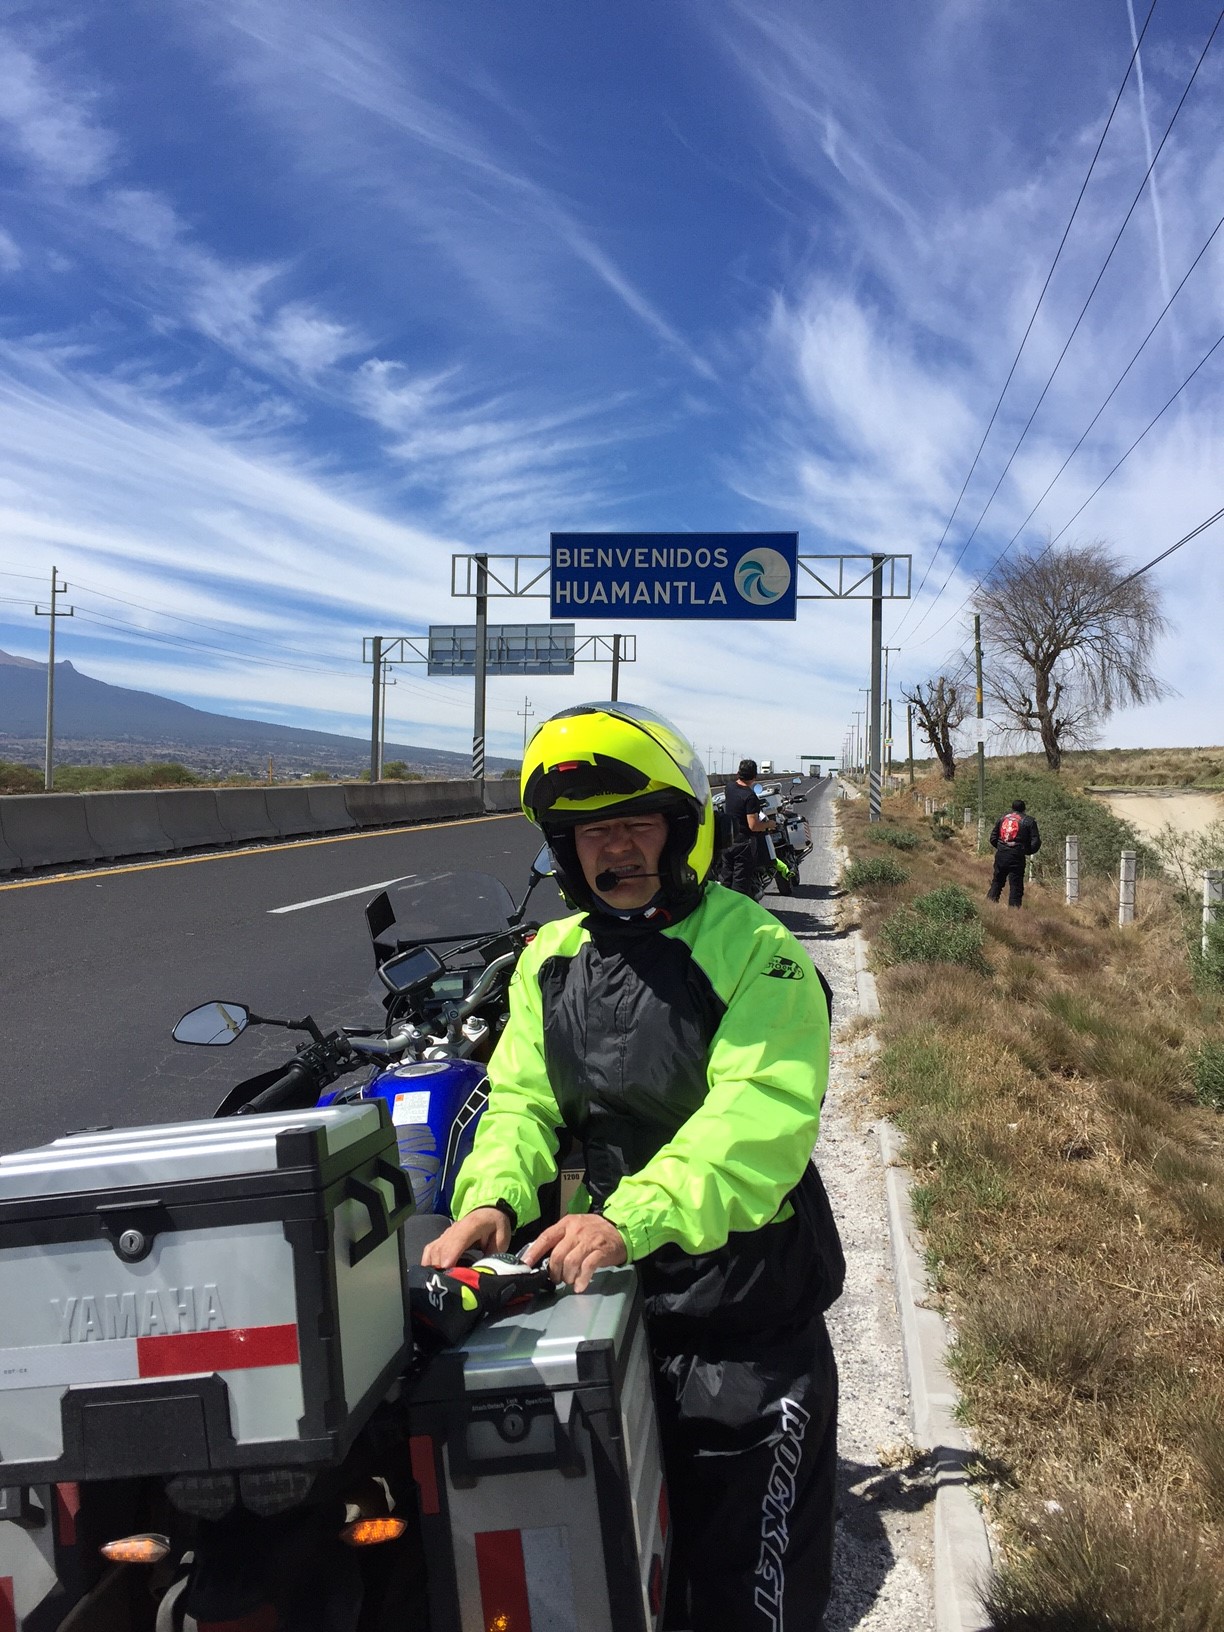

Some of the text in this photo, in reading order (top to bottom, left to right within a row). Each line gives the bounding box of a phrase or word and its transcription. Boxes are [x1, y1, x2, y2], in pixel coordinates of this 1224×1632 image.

[555, 548, 729, 568] BIENVENIDOS
[555, 581, 728, 605] HUAMANTLA
[50, 1284, 227, 1344] YAMAHA
